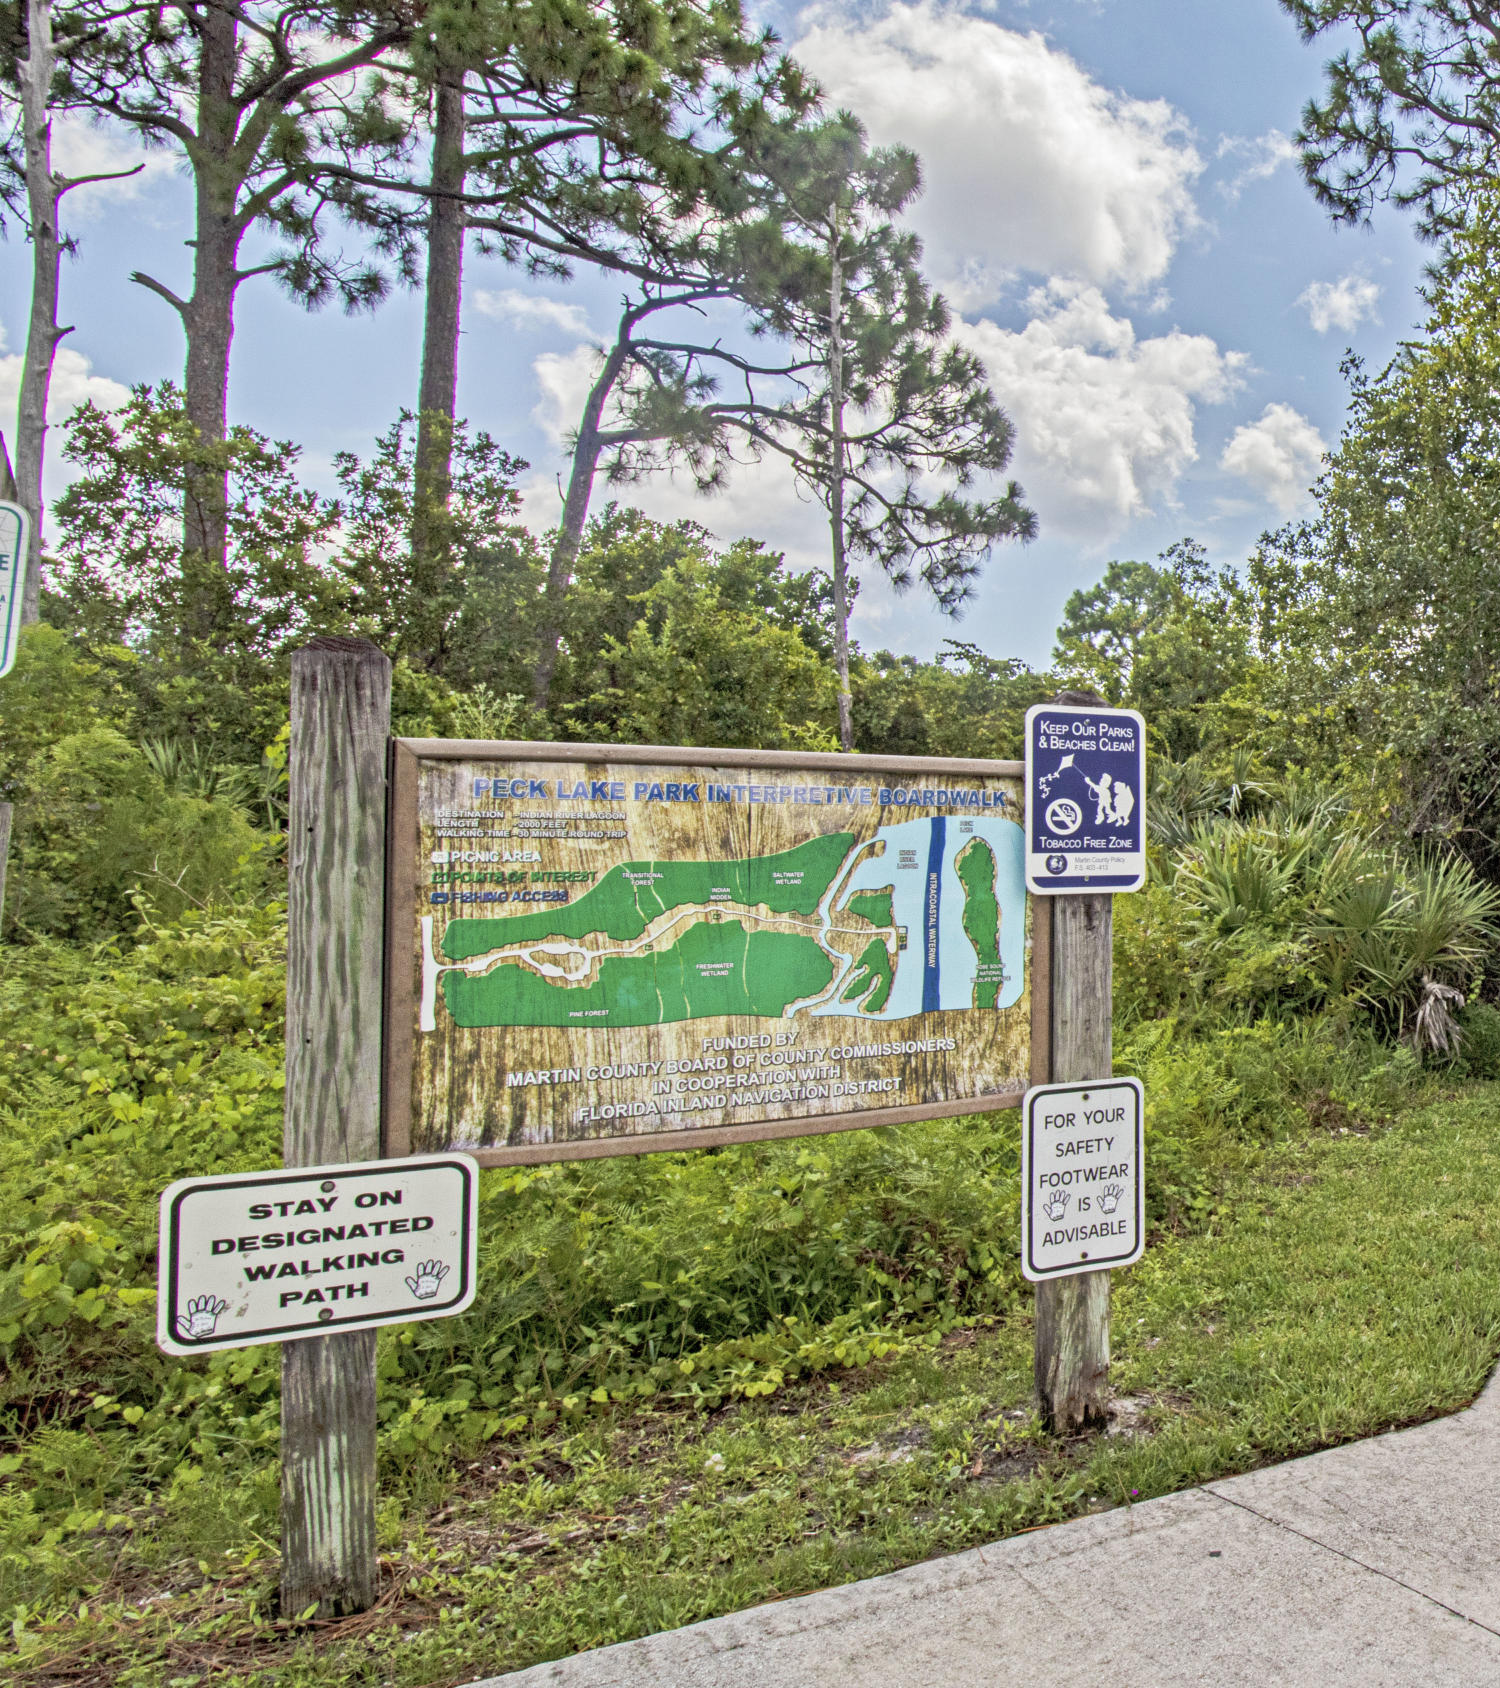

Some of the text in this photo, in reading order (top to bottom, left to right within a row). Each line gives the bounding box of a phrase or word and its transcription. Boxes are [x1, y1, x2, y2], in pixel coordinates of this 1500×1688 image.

[1038, 736, 1048, 749] &
[473, 777, 1007, 807] PECK LAKE PARK INTERPRETIVE BOARDWALK
[437, 810, 504, 819] DESTINATION
[555, 812, 583, 820] RIVER
[584, 812, 626, 821] LAGOON
[437, 820, 479, 828] LENGTH
[542, 821, 567, 829] FEET
[437, 830, 484, 838] WALKING
[486, 830, 511, 838] TIME
[531, 831, 568, 839] MINUTE
[569, 831, 604, 839] ROUND
[606, 831, 627, 839] TRIP
[451, 851, 542, 862] PICNIC AREA
[451, 870, 597, 884] POINTS OF INTEREST
[452, 890, 569, 903] FISHING ACCESS
[928, 872, 938, 968] INTRACOASTAL WATERWAY
[696, 962, 734, 970] FRESHWATER
[703, 1031, 799, 1052] FUNDED BY
[507, 1038, 956, 1087] MARTIN COUNTY BOARD OF COUNTY COMMISSIONERS
[653, 1065, 841, 1095] IN COOPERATION WITH
[579, 1077, 902, 1122] FLORIDA INLAND NAVIGATION DISTRICT
[1045, 1107, 1125, 1130] FOR YOUR
[1055, 1137, 1115, 1158] SAFETY
[1040, 1163, 1129, 1189] FOOTWEAR
[249, 1189, 402, 1220] STAY ON
[1078, 1196, 1091, 1212] IS
[211, 1216, 434, 1256] DESIGNATED
[1042, 1219, 1127, 1247] ADVISABLE
[244, 1248, 405, 1281] WALKING
[279, 1282, 369, 1308] PATH
